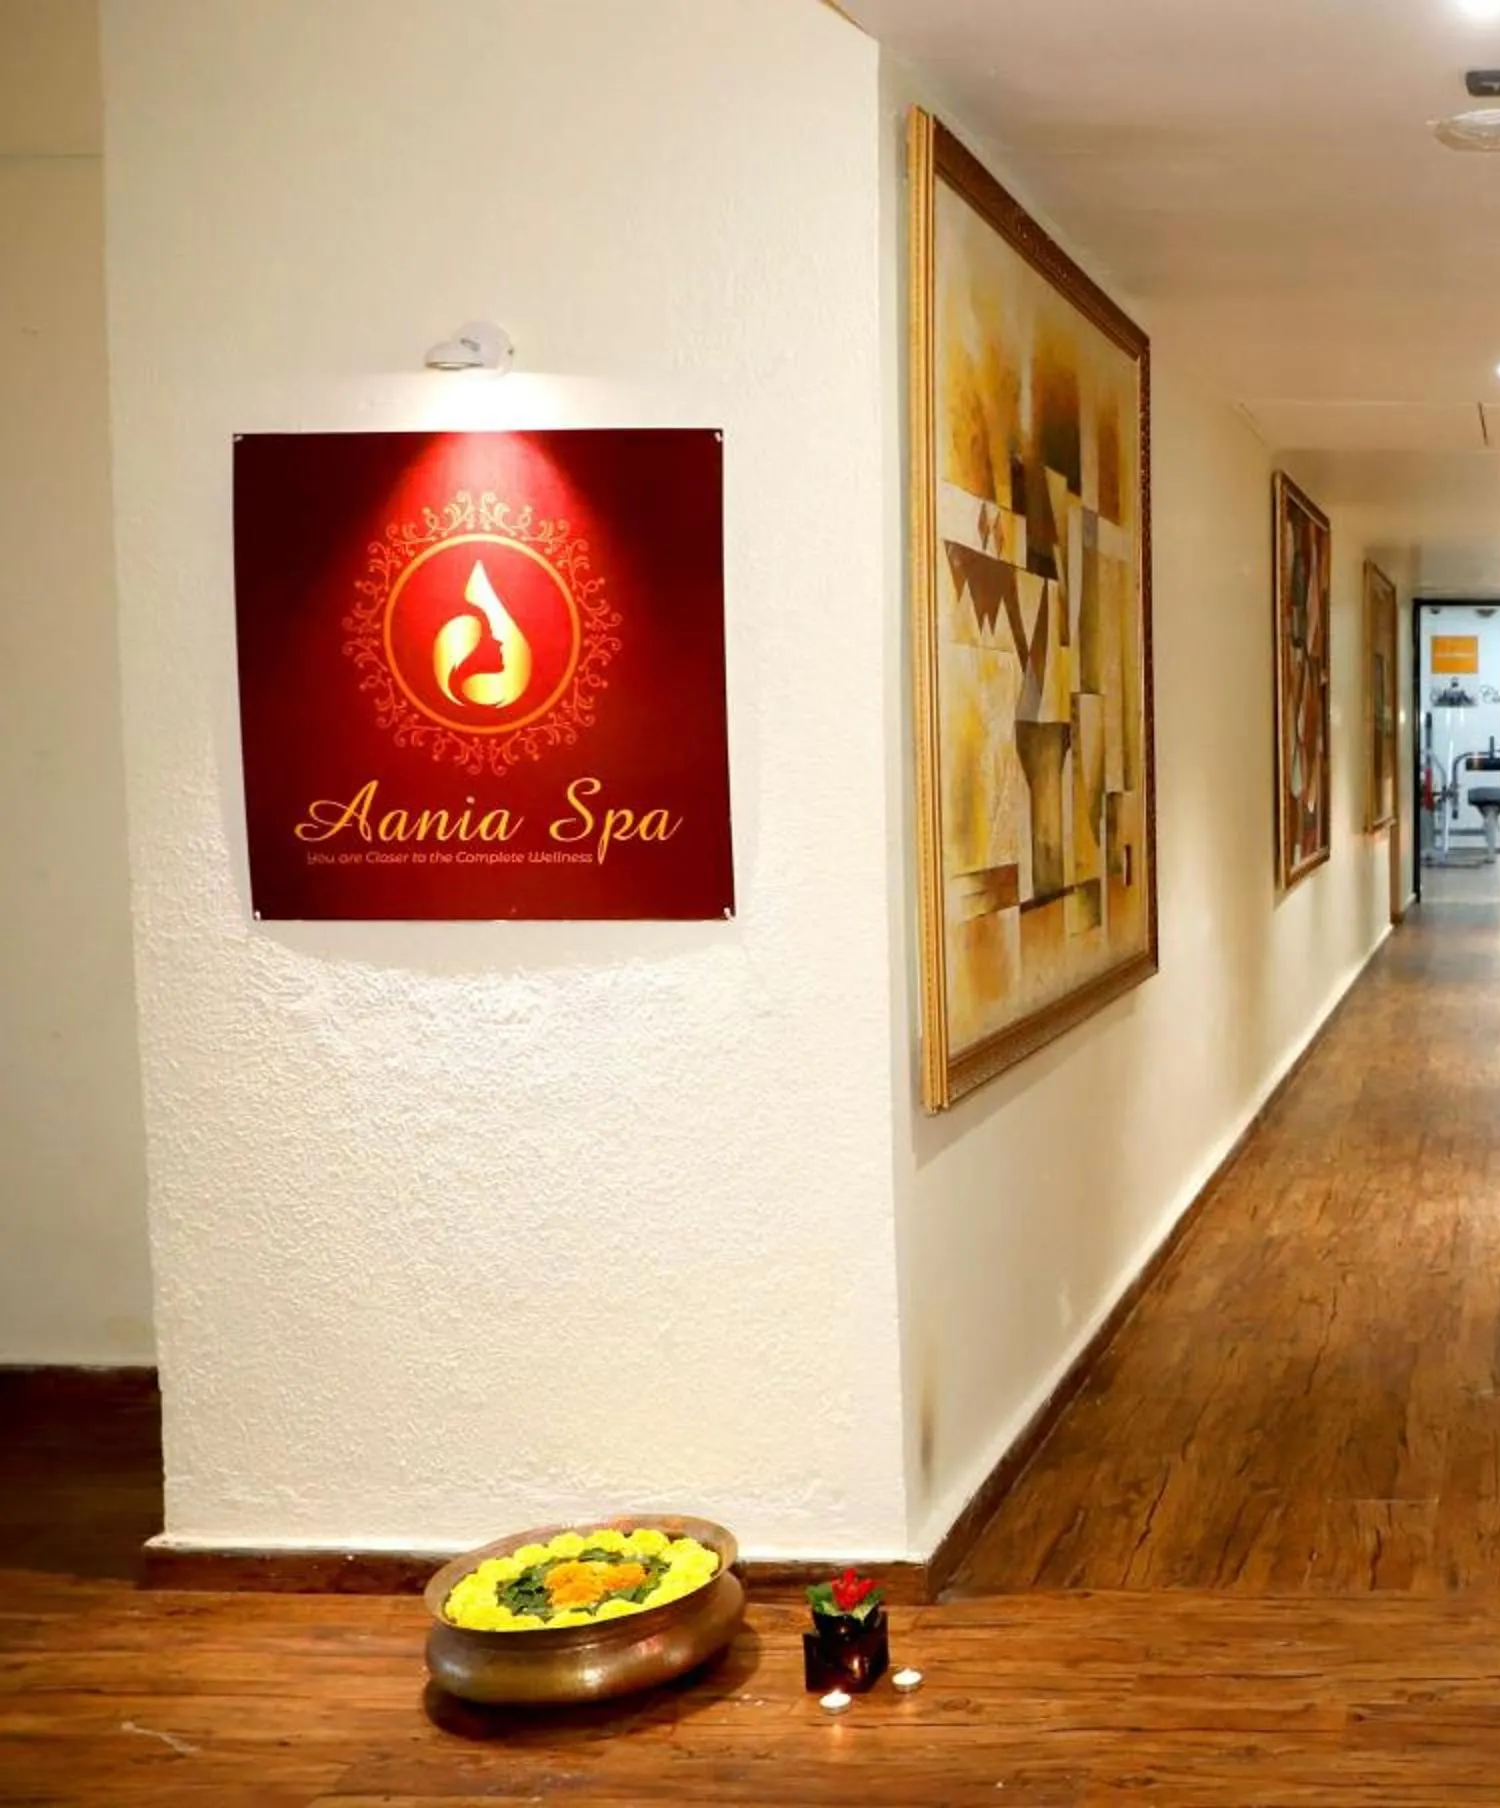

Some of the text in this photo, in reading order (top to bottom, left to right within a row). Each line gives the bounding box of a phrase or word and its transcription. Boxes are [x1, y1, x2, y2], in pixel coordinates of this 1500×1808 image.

[294, 777, 684, 865] Aania Spa
[338, 853, 362, 864] are
[365, 852, 408, 864] Closer
[412, 852, 427, 864] to
[429, 851, 454, 864] the
[455, 851, 524, 864] Complete
[527, 851, 593, 864] Wellness
